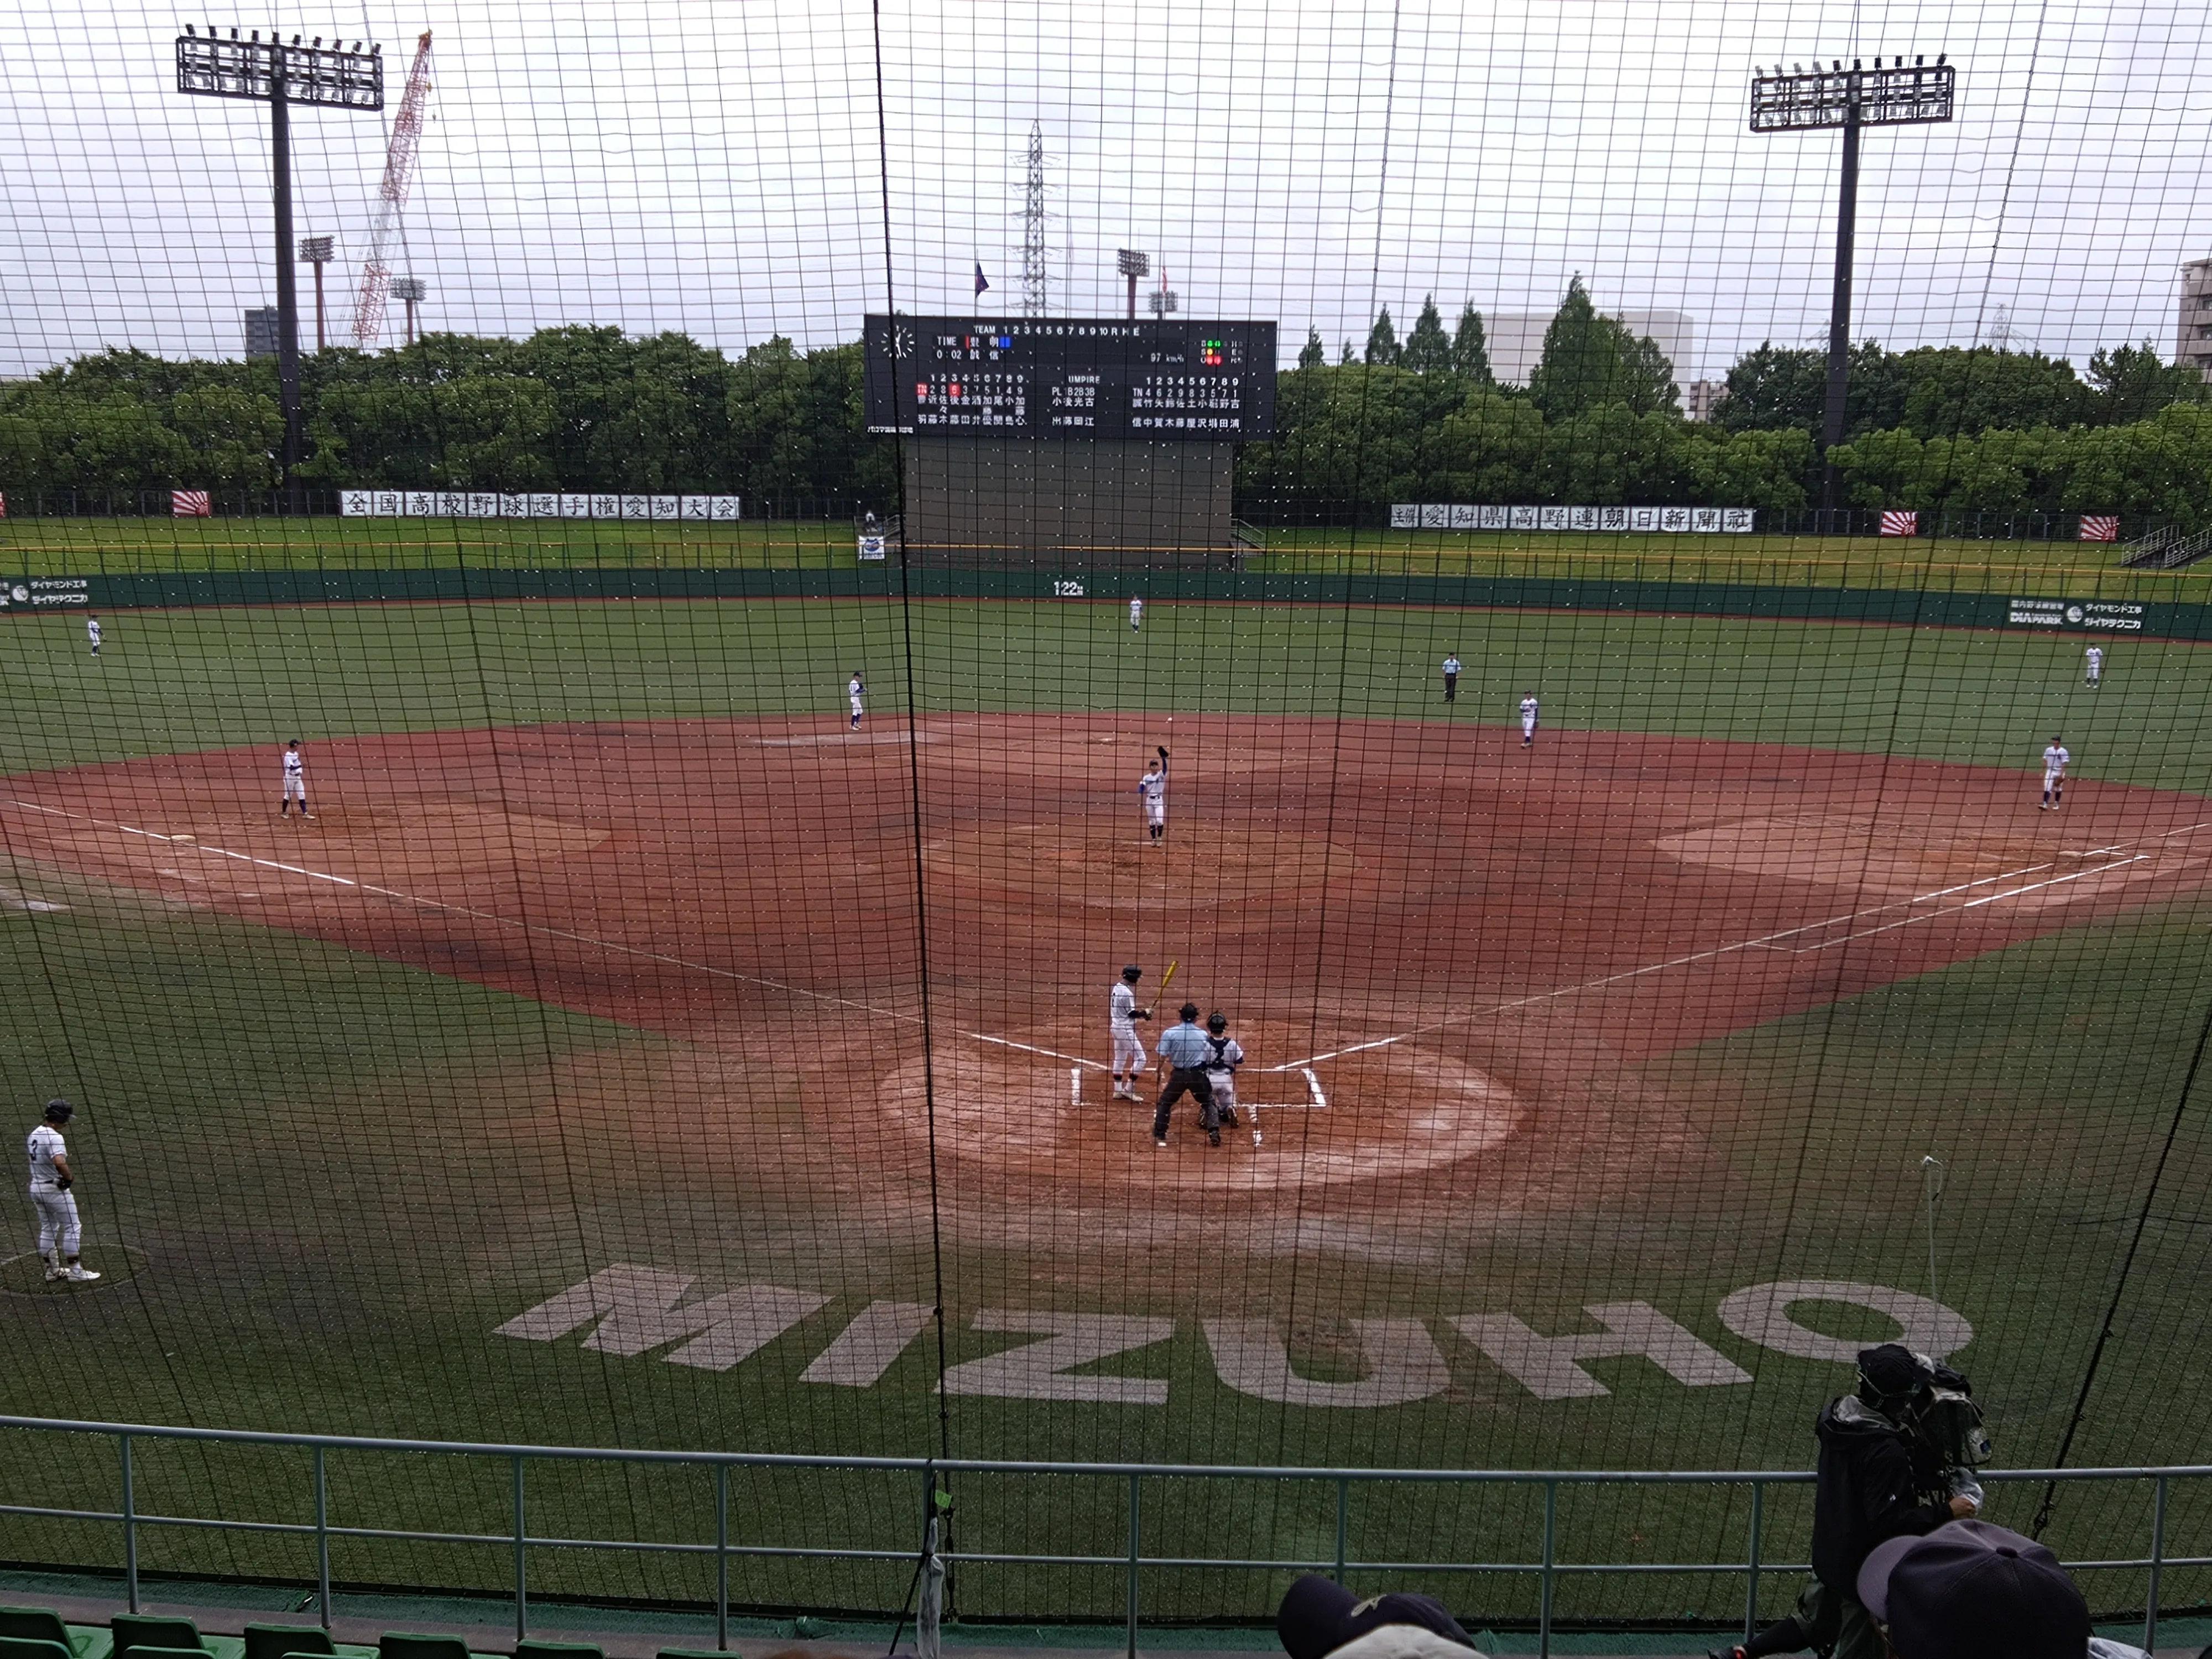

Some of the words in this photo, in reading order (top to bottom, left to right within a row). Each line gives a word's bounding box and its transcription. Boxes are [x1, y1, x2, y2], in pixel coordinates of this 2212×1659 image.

[974, 326, 995, 334] TEAM
[937, 337, 957, 346] TIME
[1150, 353, 1161, 362] 97
[1068, 375, 1100, 384] UMPIRE
[1052, 387, 1062, 396] PL
[1063, 387, 1073, 396] 1B
[1074, 387, 1084, 396] 2B
[1084, 387, 1095, 396] 3B
[1133, 388, 1142, 397] TN
[1145, 388, 1151, 397] 4
[1156, 388, 1162, 397] 6
[1167, 388, 1172, 397] 2
[1178, 389, 1183, 398] 9
[1189, 389, 1194, 398] 8
[1200, 389, 1206, 398] 3
[1211, 389, 1216, 398] 5
[1222, 389, 1227, 398] 7
[1234, 389, 1237, 398] 1
[348, 492, 735, 517] 全国高校野球選手権愛知大会
[2086, 603, 2142, 614] ダイヤモンド工事
[30, 1139, 37, 1161] 3
[493, 1262, 1973, 1408] MIZUHO
